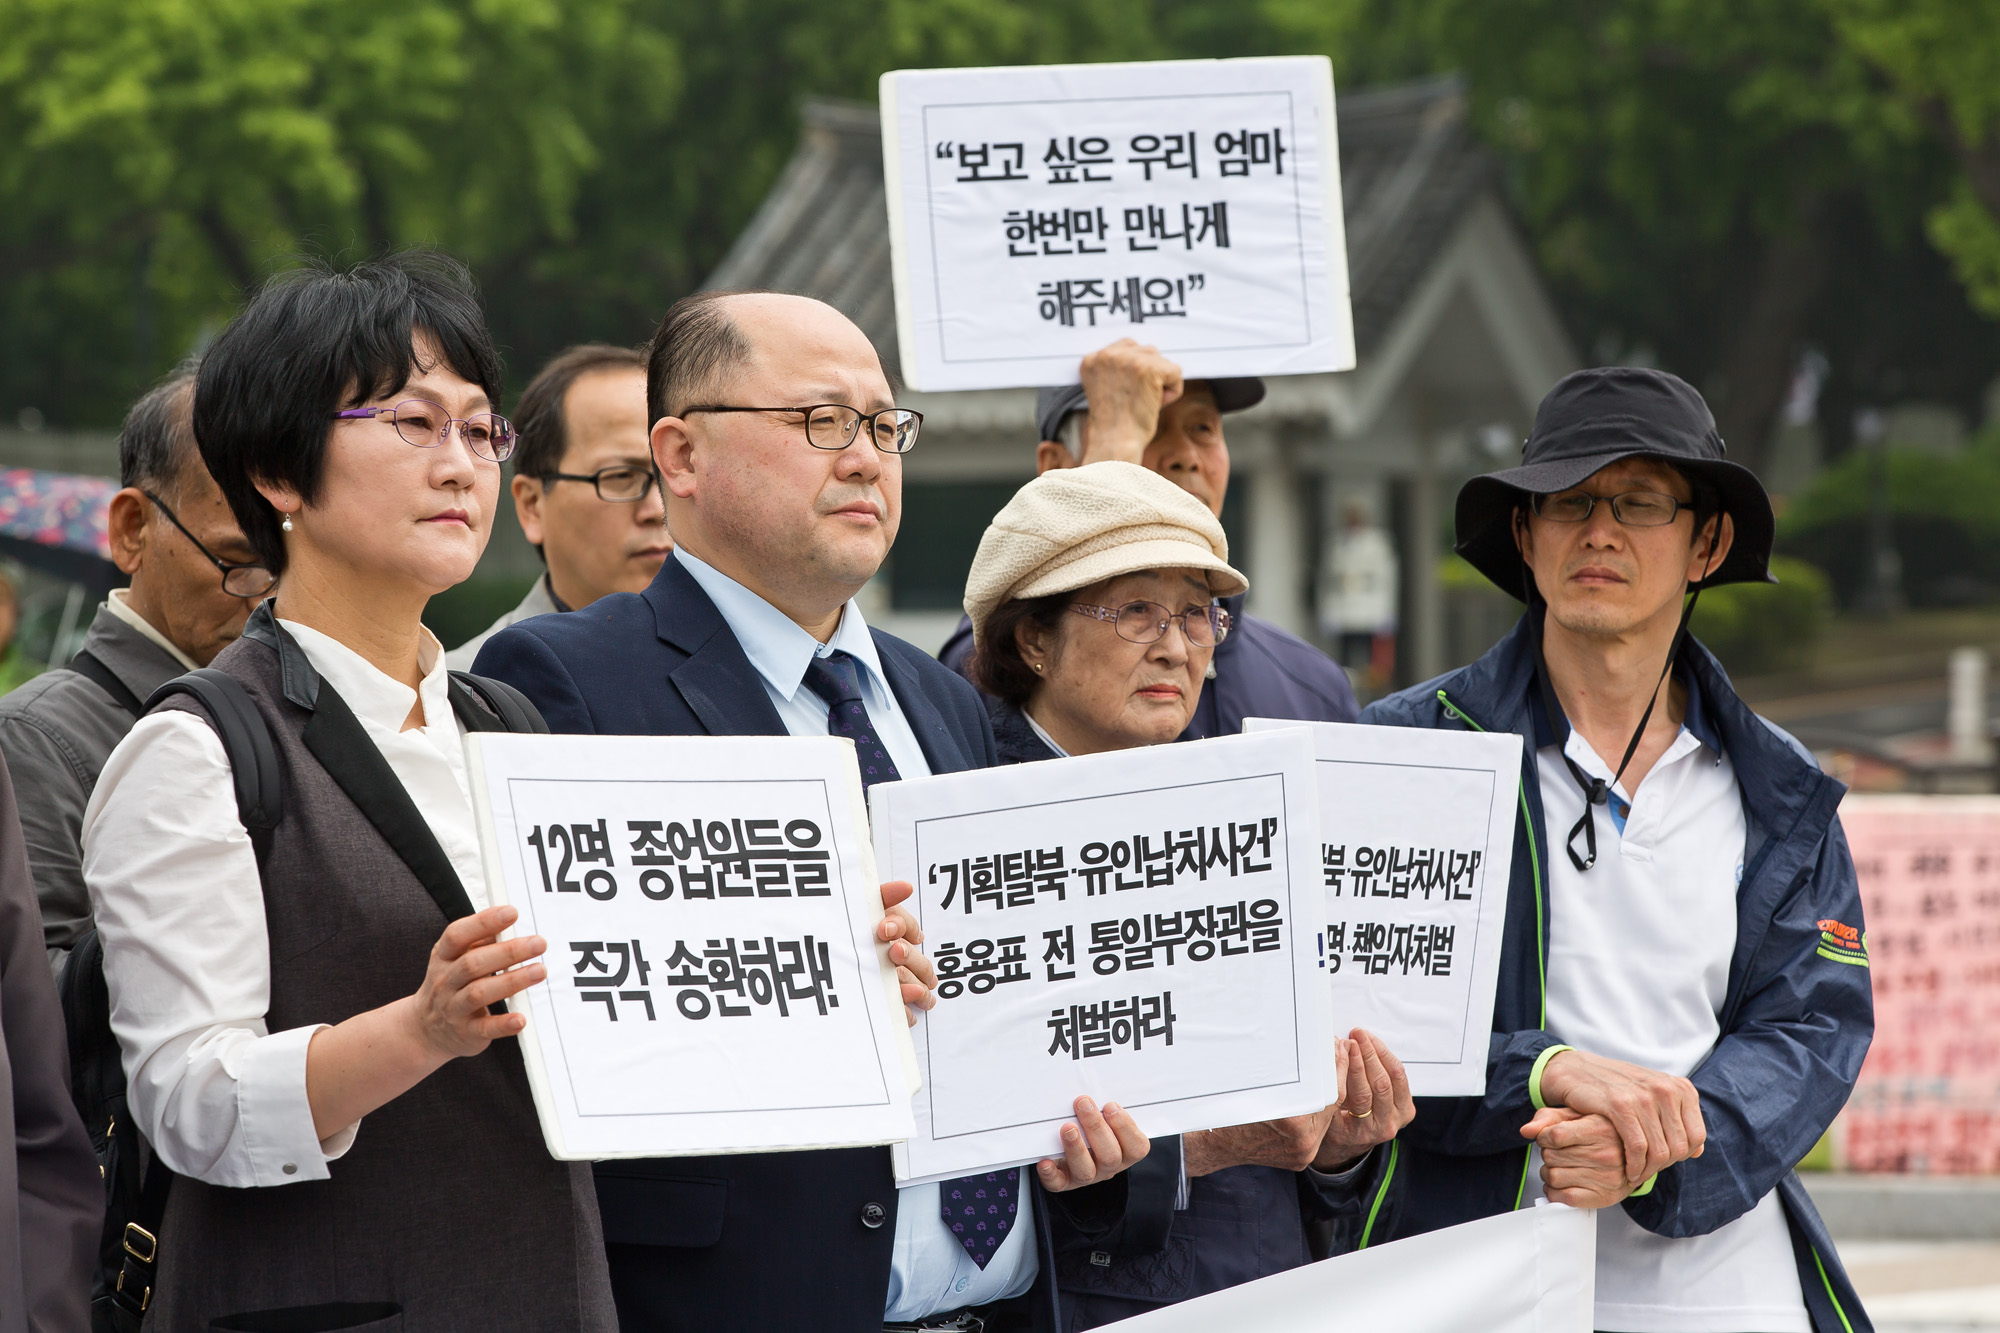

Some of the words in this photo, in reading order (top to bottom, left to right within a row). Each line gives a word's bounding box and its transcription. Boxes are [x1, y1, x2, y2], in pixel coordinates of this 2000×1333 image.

[936, 141, 1029, 183] “보고
[1043, 136, 1114, 185] 싶은
[1128, 131, 1198, 181] 우리
[1214, 128, 1287, 178] 엄마
[1002, 207, 1109, 257] 한번만
[1124, 201, 1230, 252] 만나게
[1037, 273, 1205, 327] 해주세요!”
[527, 818, 618, 901] 12명
[627, 818, 832, 901] 종업원들을
[1322, 843, 1482, 901] 북·유인납치사건’
[569, 939, 657, 1022] 즉각
[665, 935, 840, 1021] 송환하라!
[932, 935, 1031, 1000] 홍용표
[1042, 924, 1076, 983] 전
[1088, 898, 1283, 976] 통일부장관을
[1046, 991, 1177, 1061] 처벌하라
